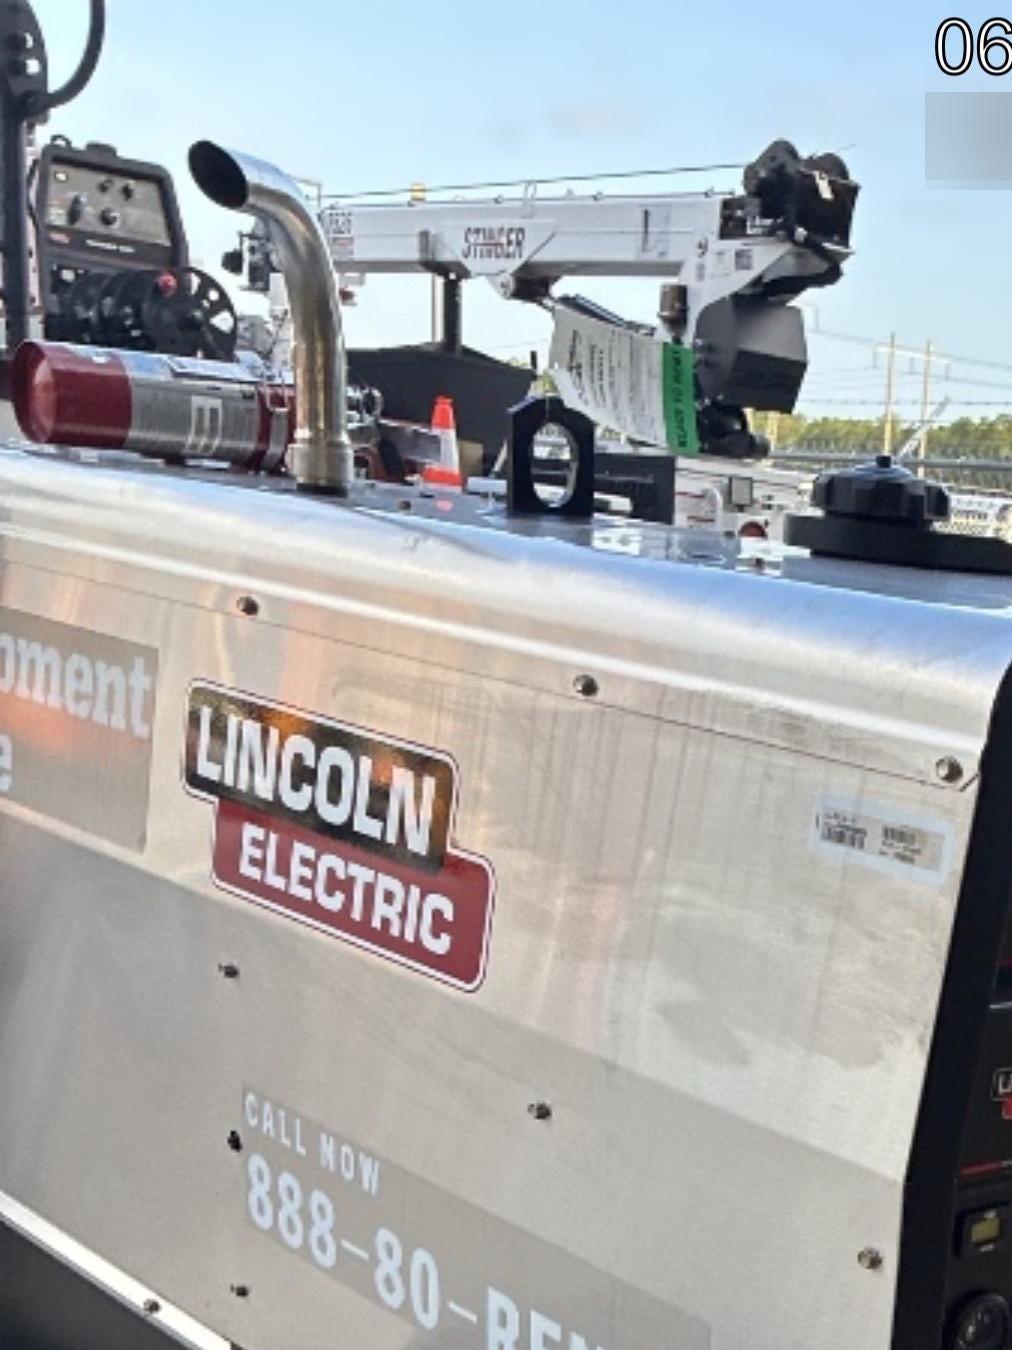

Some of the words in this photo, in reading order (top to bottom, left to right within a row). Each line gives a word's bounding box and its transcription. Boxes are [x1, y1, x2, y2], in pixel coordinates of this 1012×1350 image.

[0, 632, 153, 739] ment
[196, 703, 436, 857] LINCOLN
[239, 821, 455, 956] ELECTRIC
[245, 1092, 307, 1156] CALL
[320, 1132, 380, 1197] NOW
